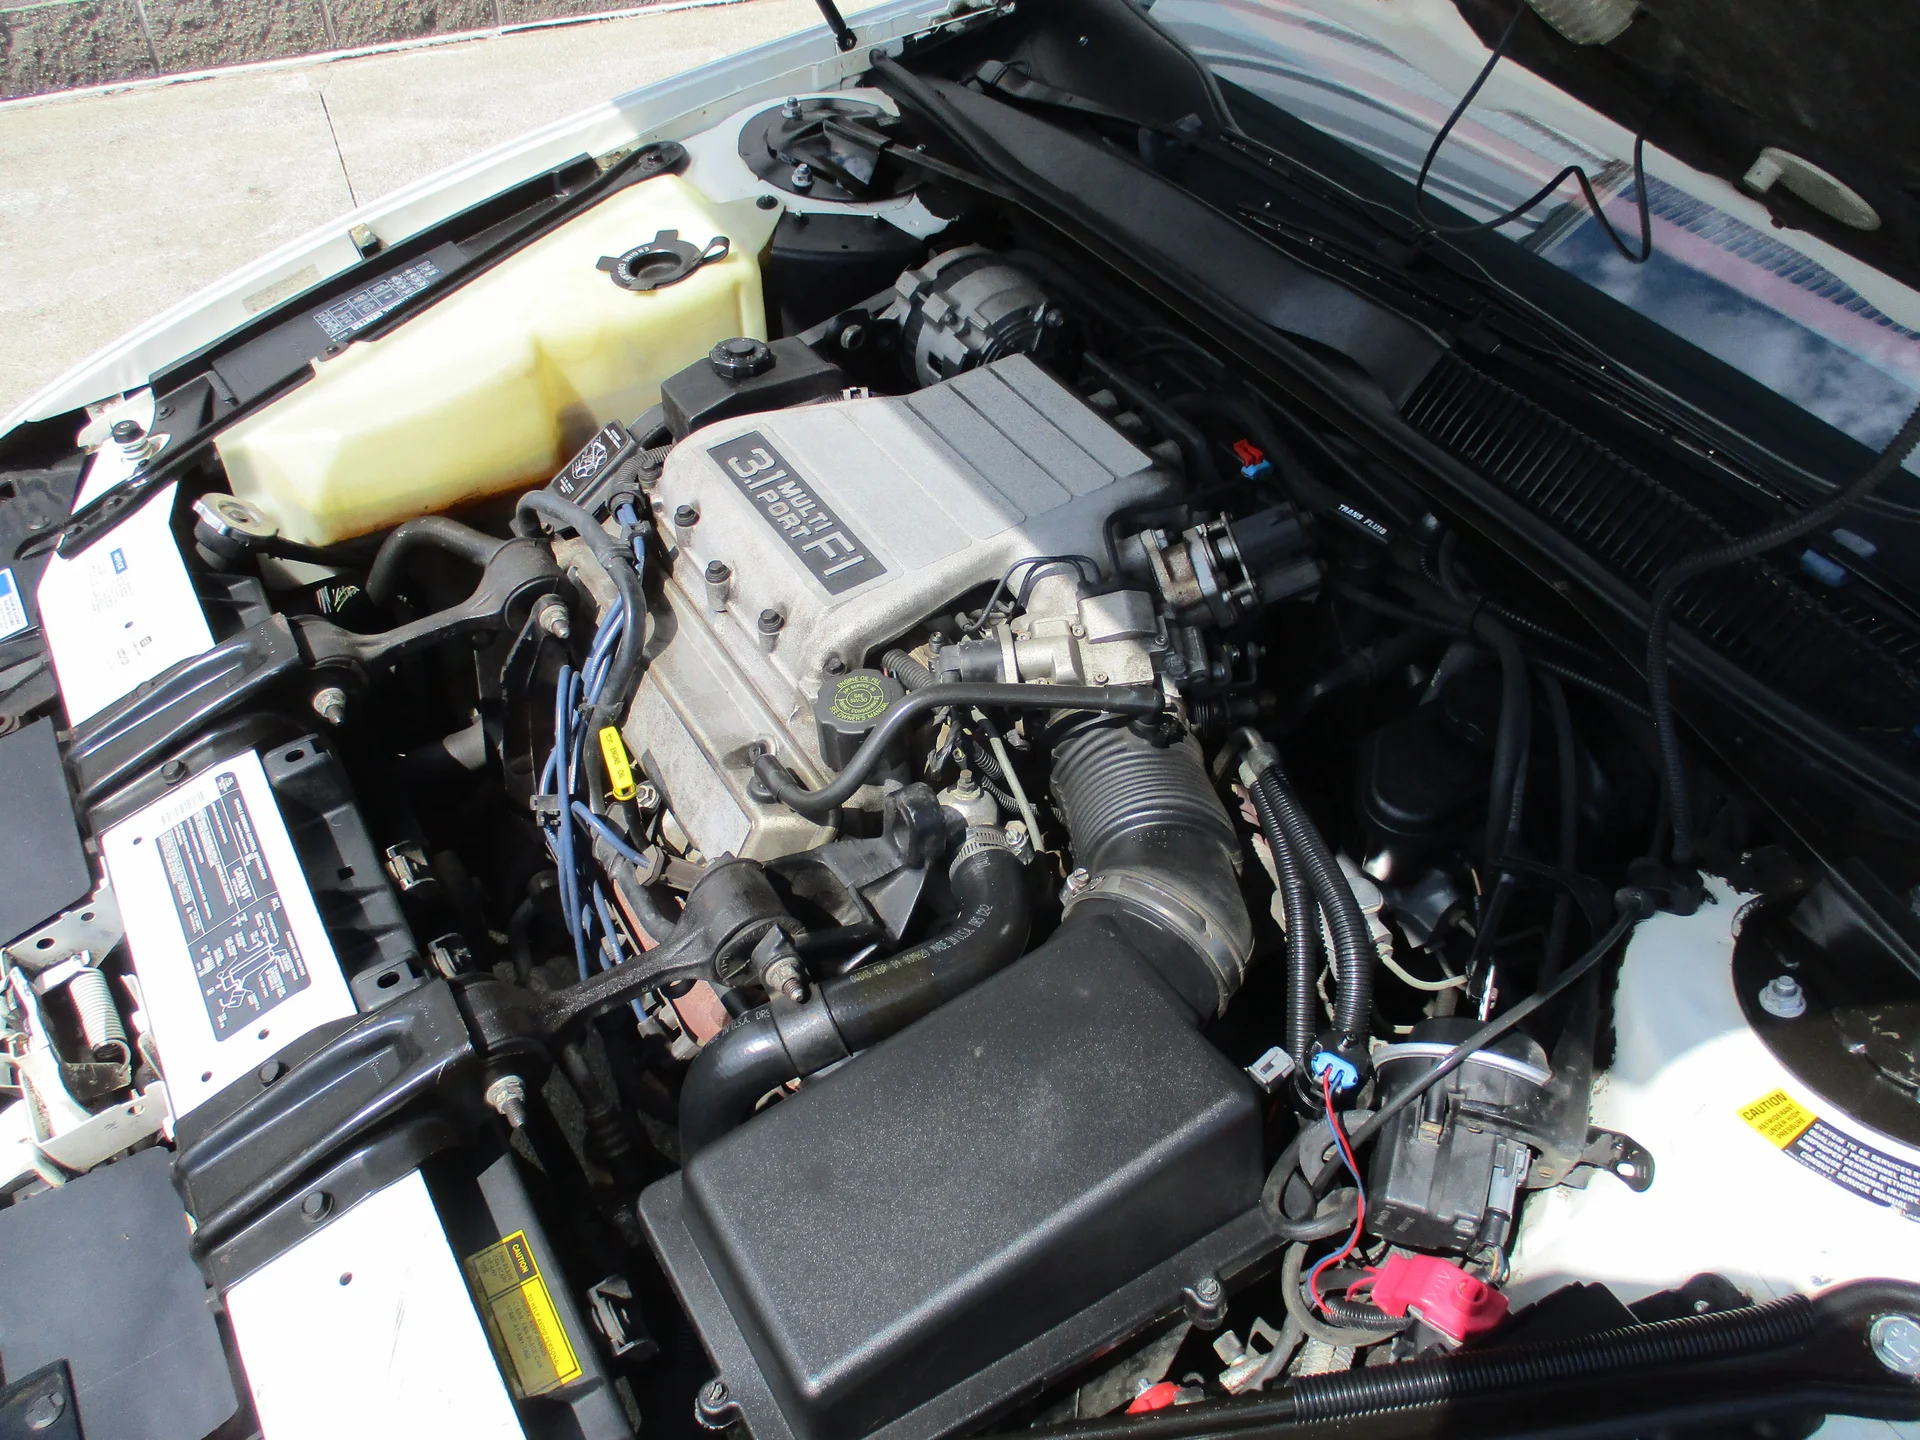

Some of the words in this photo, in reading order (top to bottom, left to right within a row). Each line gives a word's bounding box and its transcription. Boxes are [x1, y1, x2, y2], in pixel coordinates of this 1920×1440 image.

[621, 246, 650, 263] ENGINE
[727, 448, 787, 491] 3.1
[756, 489, 812, 539] PORT
[777, 480, 833, 533] MULTI
[1338, 503, 1363, 520] TRANS
[1362, 517, 1387, 535] FLUID
[802, 531, 864, 577] FI
[836, 675, 857, 688] ENGINE
[829, 705, 838, 714] SEE
[867, 702, 889, 718] MANUAL
[610, 747, 620, 764] ENGINE
[617, 769, 625, 778] OIL
[232, 866, 252, 900] CATALYST
[929, 939, 951, 954] MADE
[721, 1026, 729, 1036] IN
[730, 1016, 750, 1030] U.S.A.
[1743, 1092, 1787, 1121] CAUTION
[1758, 1104, 1795, 1131] REFRIGERANT
[1769, 1120, 1787, 1135] UNDER
[1786, 1110, 1800, 1123] HIGH
[1777, 1118, 1805, 1139] PRESSURE
[1809, 1129, 1848, 1154] QUALIFIED
[1849, 1152, 1898, 1180] PERSONNEL
[1814, 1123, 1846, 1144] SYSTEM
[1846, 1142, 1857, 1151] TO
[1858, 1148, 1870, 1158] BE
[1871, 1154, 1912, 1175] SERVICED
[1797, 1140, 1815, 1153] MAY
[1814, 1151, 1842, 1169] CAUSE
[1842, 1165, 1886, 1191] PERSONAL
[1800, 1151, 1836, 1174] CONSULT
[1837, 1171, 1872, 1194] SERVICE
[1872, 1189, 1908, 1210] MANUAL
[1803, 1134, 1843, 1160] IMPROPER
[1843, 1157, 1878, 1178] SERVICE
[1879, 1174, 1920, 1196] METHODS
[512, 1242, 528, 1273] CAUTION
[505, 1304, 516, 1322] START
[527, 1293, 533, 1302] TO
[531, 1302, 540, 1318] HELP
[537, 1317, 548, 1336] AVOID
[545, 1336, 560, 1367] PERSONAL
